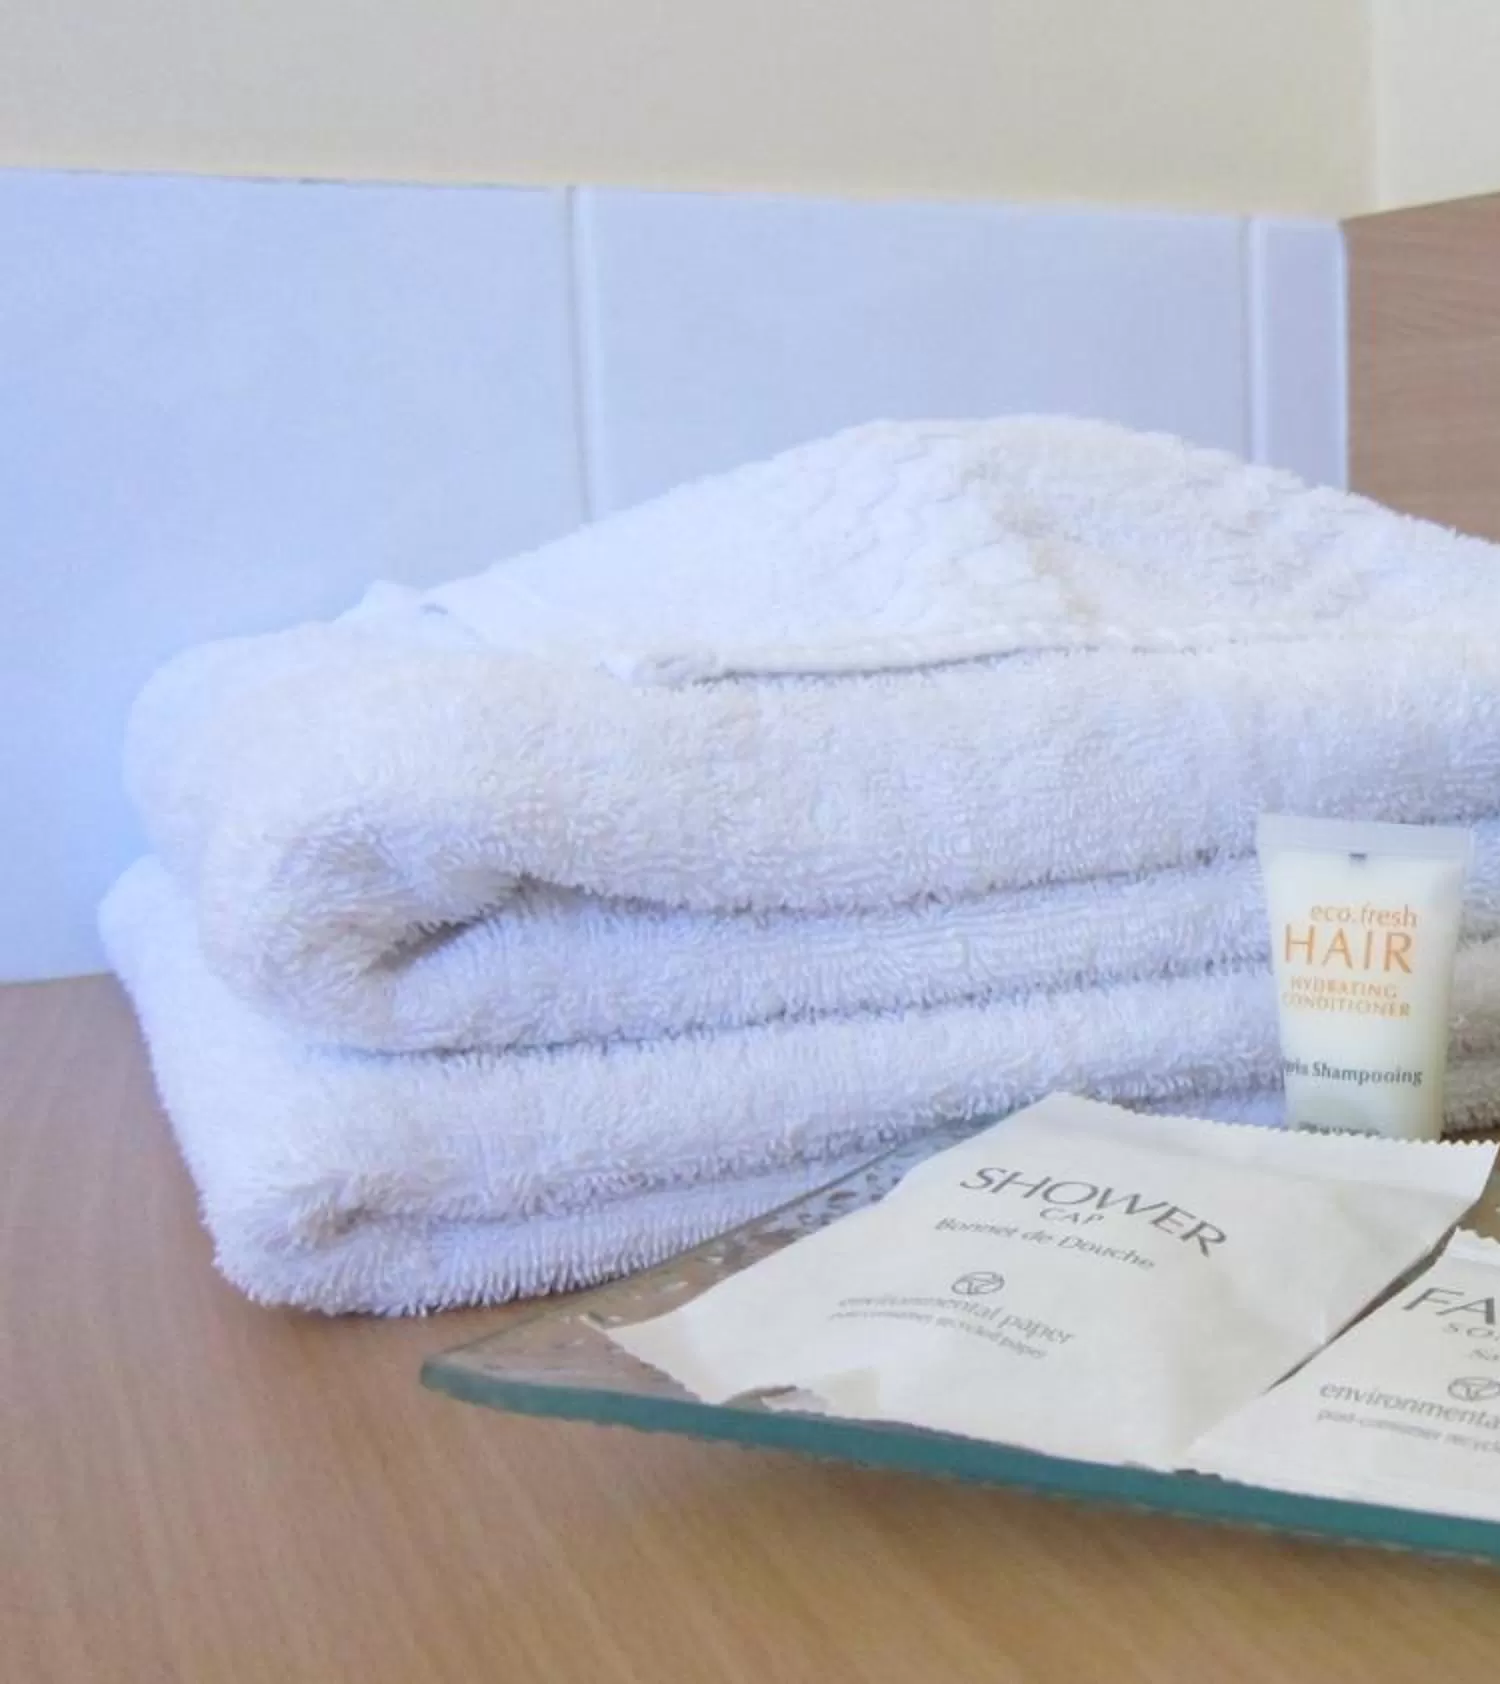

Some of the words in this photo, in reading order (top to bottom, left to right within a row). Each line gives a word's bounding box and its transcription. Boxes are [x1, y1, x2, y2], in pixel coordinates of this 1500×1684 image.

[1310, 902, 1418, 928] eco.fresh
[1284, 924, 1413, 974] HAIR
[1311, 1061, 1424, 1087] Shampooing
[959, 1166, 1228, 1258] SHOWER
[1039, 1207, 1106, 1225] CAP
[934, 1217, 1019, 1238] Bonnet
[1021, 1229, 1053, 1244] de
[1057, 1234, 1157, 1269] Douche
[997, 1314, 1077, 1344] paper
